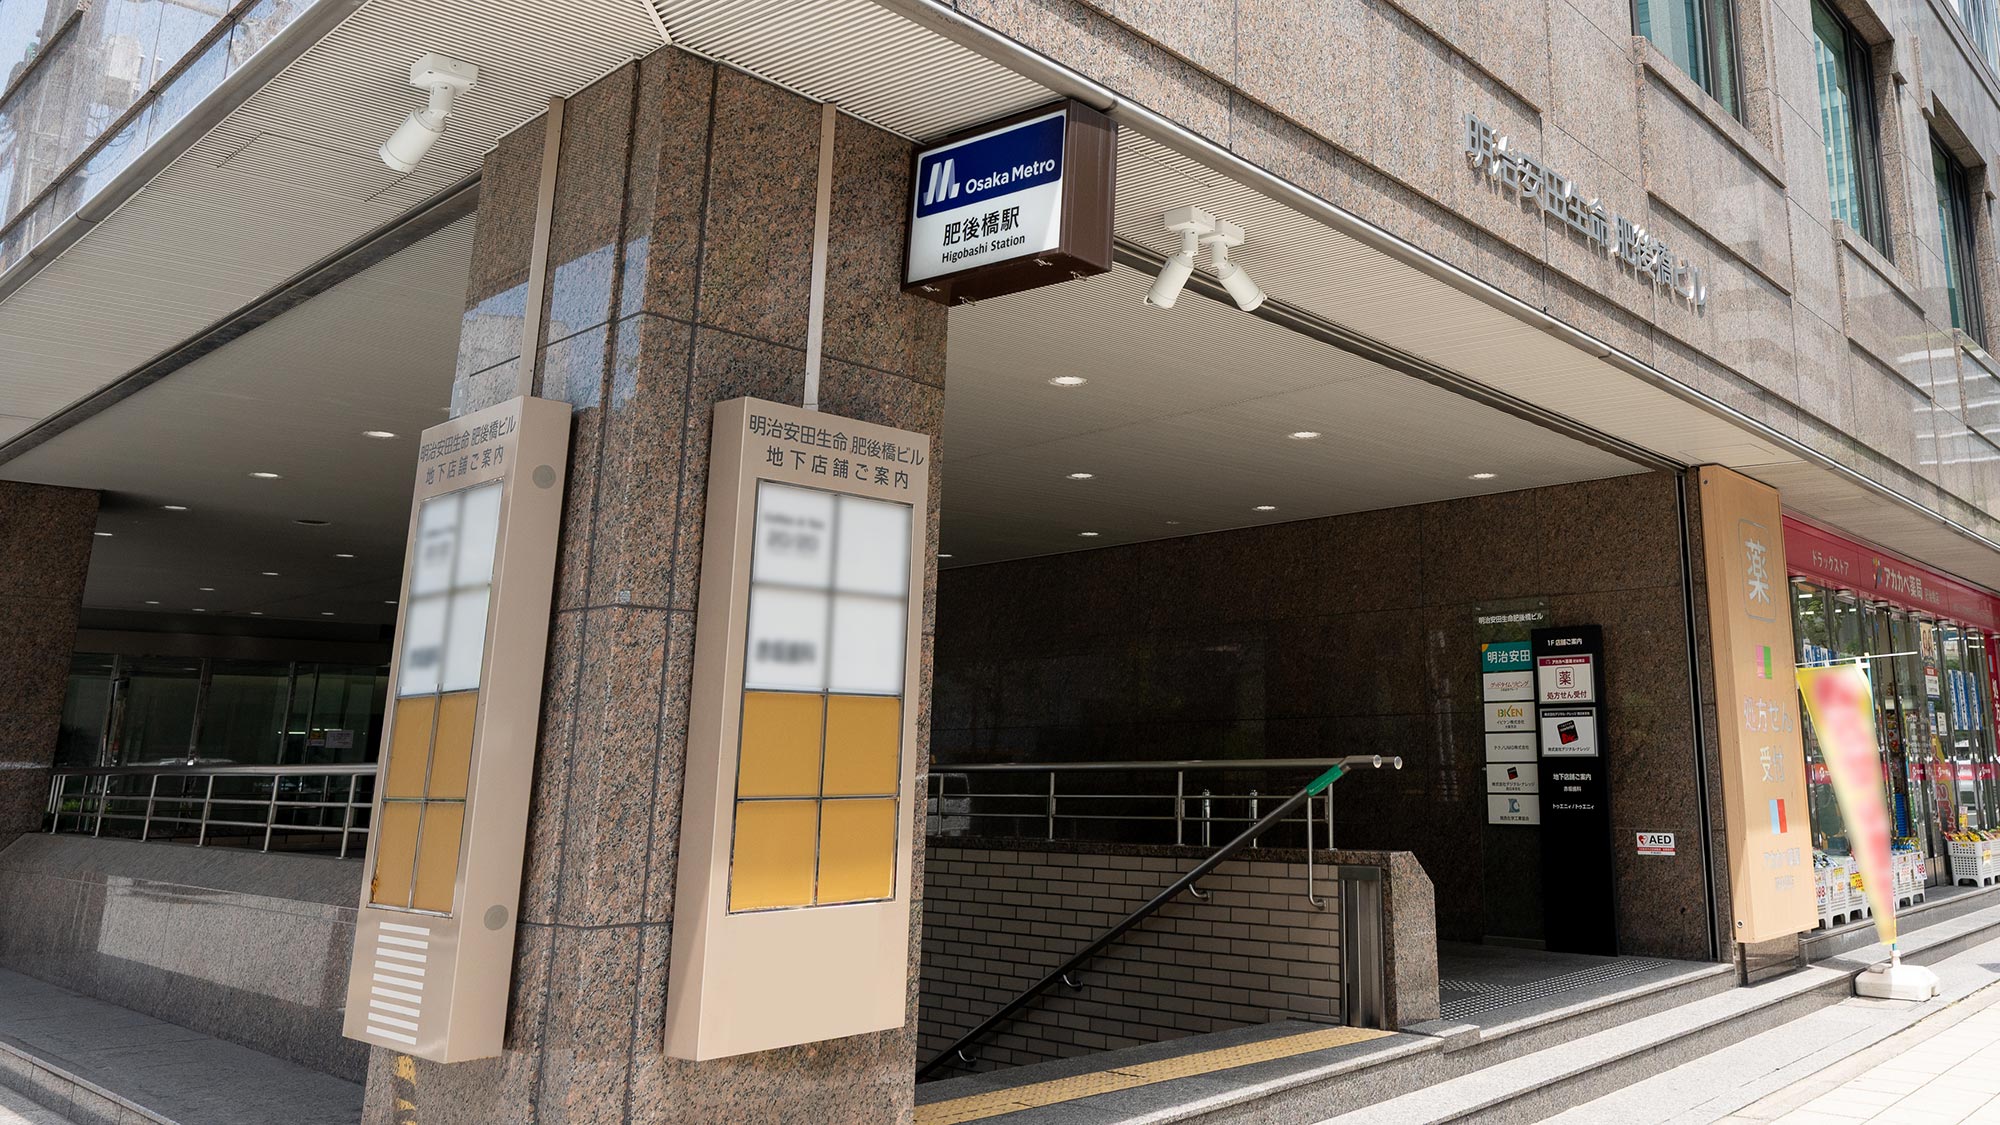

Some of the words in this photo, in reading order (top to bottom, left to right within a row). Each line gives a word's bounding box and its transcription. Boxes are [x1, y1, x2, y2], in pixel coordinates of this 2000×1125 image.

[965, 170, 1010, 194] Osaka
[1012, 159, 1056, 182] Metro
[942, 206, 1020, 247] 肥後橋駅
[1464, 113, 1609, 247] 明治安田生命
[1610, 213, 1706, 305] 肥後橋ビル
[941, 242, 988, 264] Higobashi
[991, 234, 1026, 251] Station
[420, 430, 470, 463] 明治安田生命
[471, 415, 516, 447] 肥後橋ビル
[749, 414, 848, 452] 明治安田生命
[851, 436, 925, 466] 肥後橋ビル
[425, 444, 504, 485] 地下店舗ご案内
[766, 445, 909, 490] 地下店舗ご案内
[1744, 538, 1770, 605] 薬
[1811, 549, 1850, 577] ドラッグストア
[1883, 566, 1923, 600] アカカベ薬局
[1487, 649, 1531, 664] 明治安田
[1546, 690, 1587, 700] 処方せん受付
[1559, 670, 1572, 685] 薬
[1743, 696, 1793, 734] 処方せん
[1759, 745, 1785, 782] 受付
[1649, 835, 1672, 845] AED
